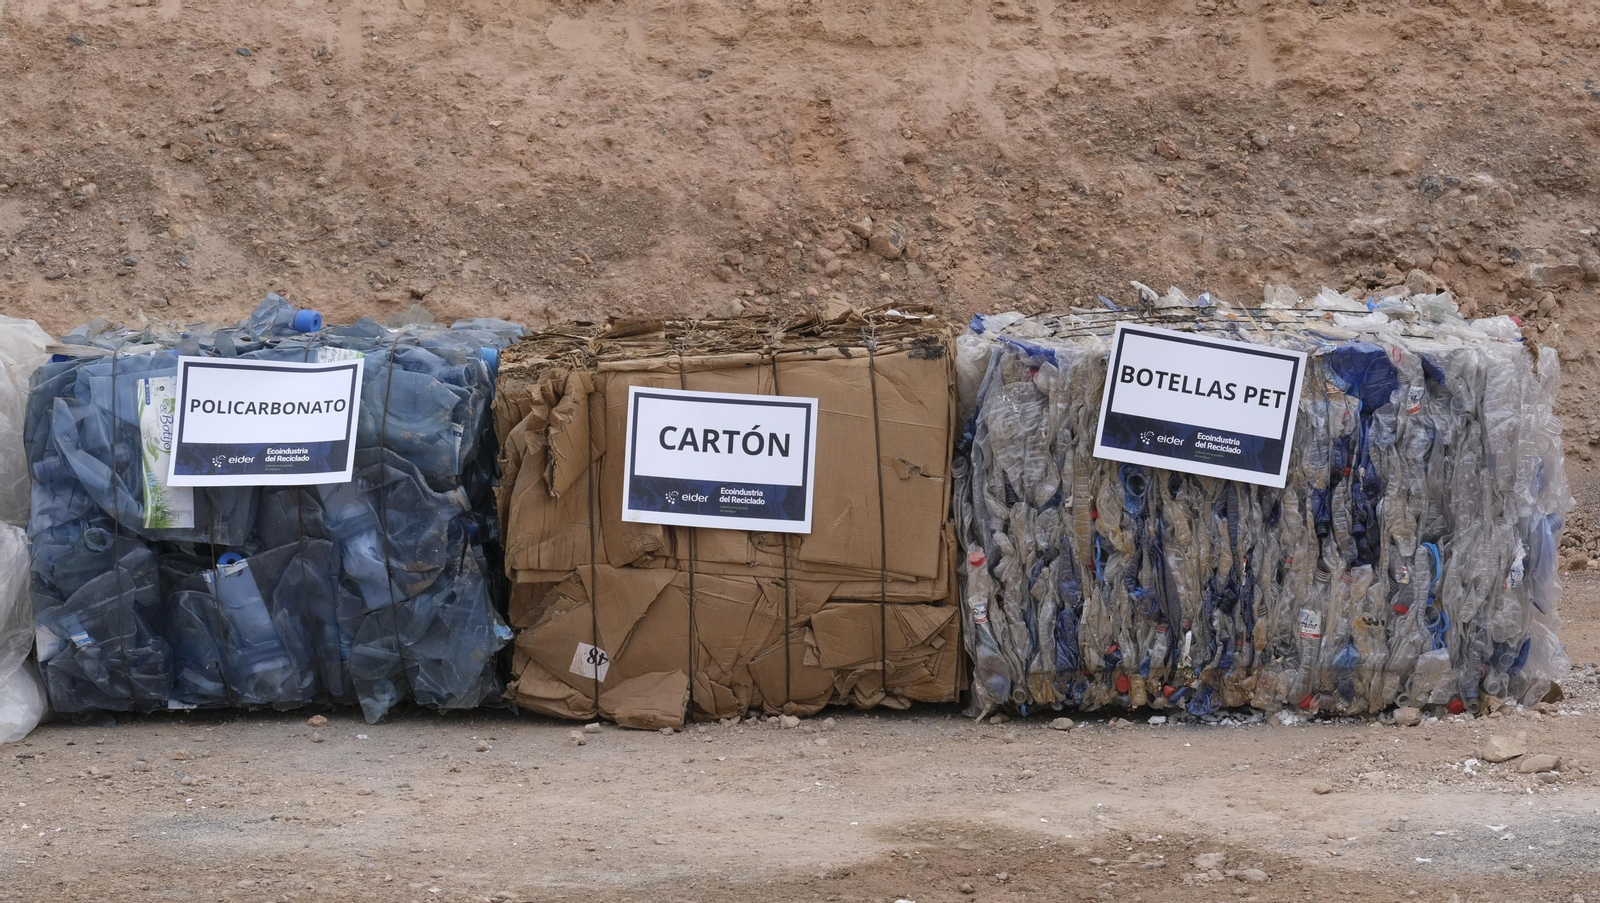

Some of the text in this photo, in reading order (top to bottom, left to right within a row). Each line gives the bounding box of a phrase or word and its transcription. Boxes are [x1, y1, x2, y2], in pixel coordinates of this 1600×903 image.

[1120, 365, 1286, 409] BOTELLAS PET
[190, 398, 346, 415] POLICARBONATO
[659, 425, 790, 457] CARTÓN
[1156, 434, 1185, 446] eider
[1197, 432, 1240, 446] Ecoindustria
[266, 447, 309, 455] Ecoindustria
[1195, 440, 1206, 449] del
[1207, 442, 1241, 455] Reciclado
[228, 455, 255, 464] eider
[276, 454, 310, 462] Reciclado
[681, 493, 709, 503] eider
[720, 487, 764, 497] Ecoindustria
[719, 495, 765, 505] del Reciclado
[586, 647, 609, 667] 48
